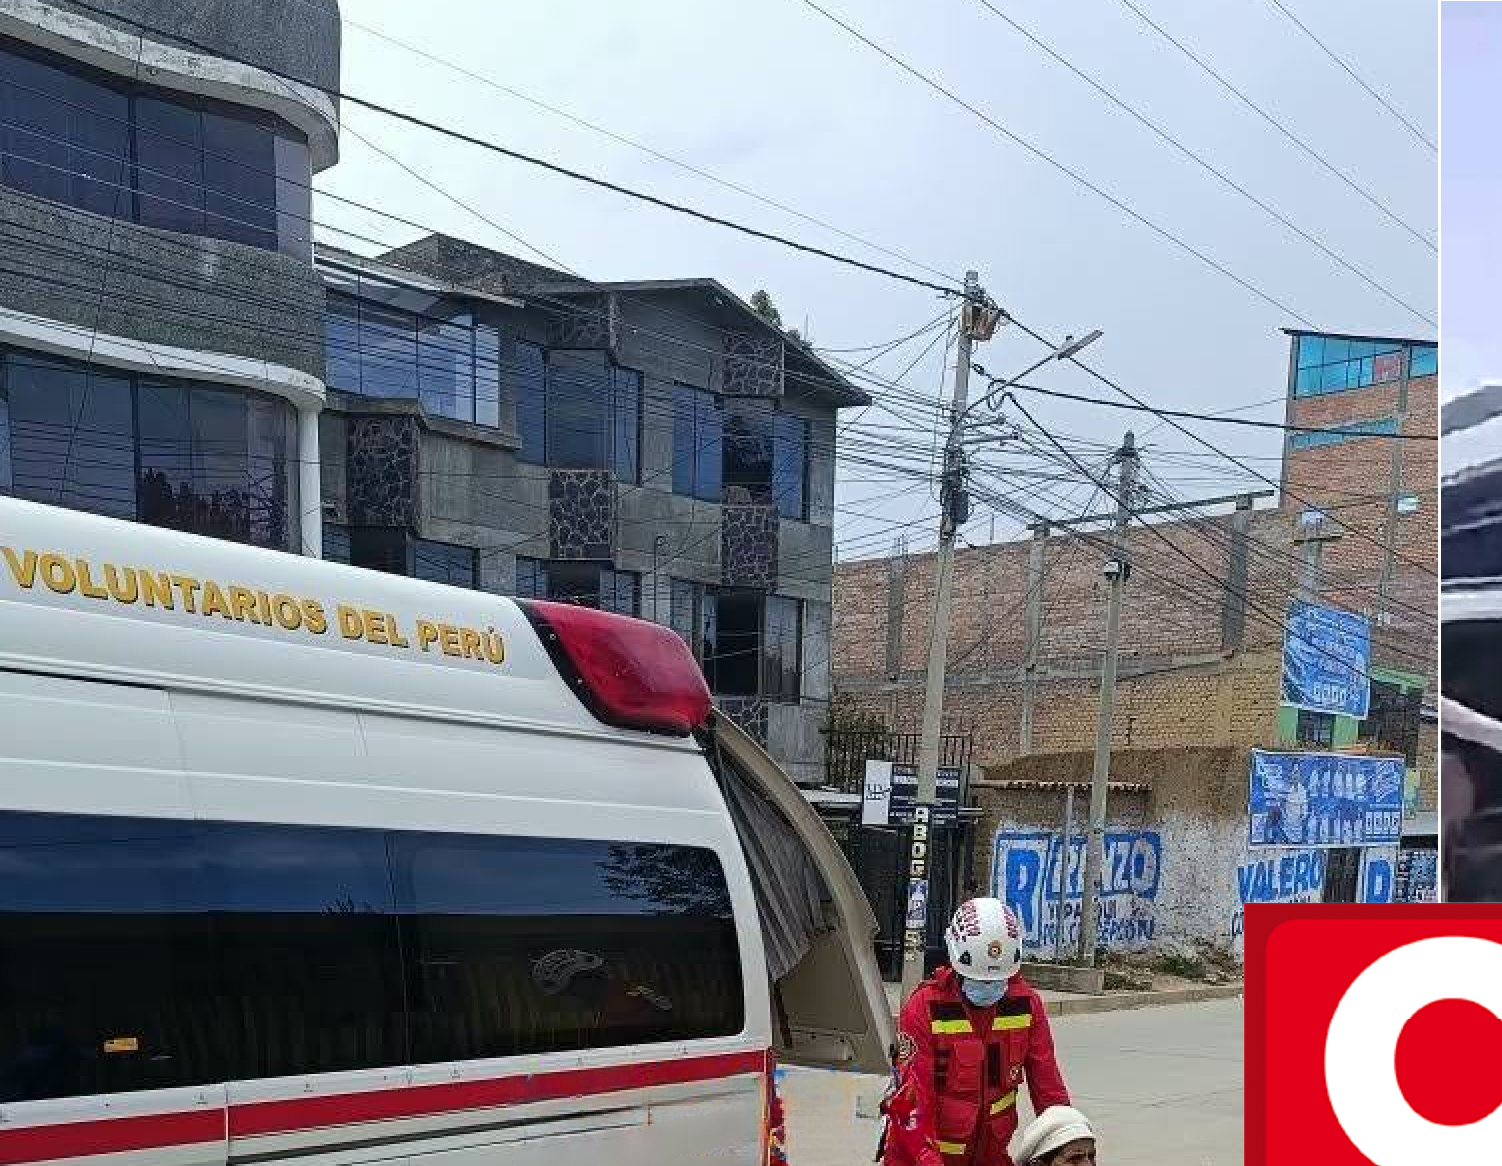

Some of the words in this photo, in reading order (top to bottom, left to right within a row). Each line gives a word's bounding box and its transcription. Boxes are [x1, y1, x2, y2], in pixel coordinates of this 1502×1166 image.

[2, 547, 327, 634] VOLUNTARIOS
[338, 603, 408, 648] DEL
[417, 618, 505, 665] PERÚ
